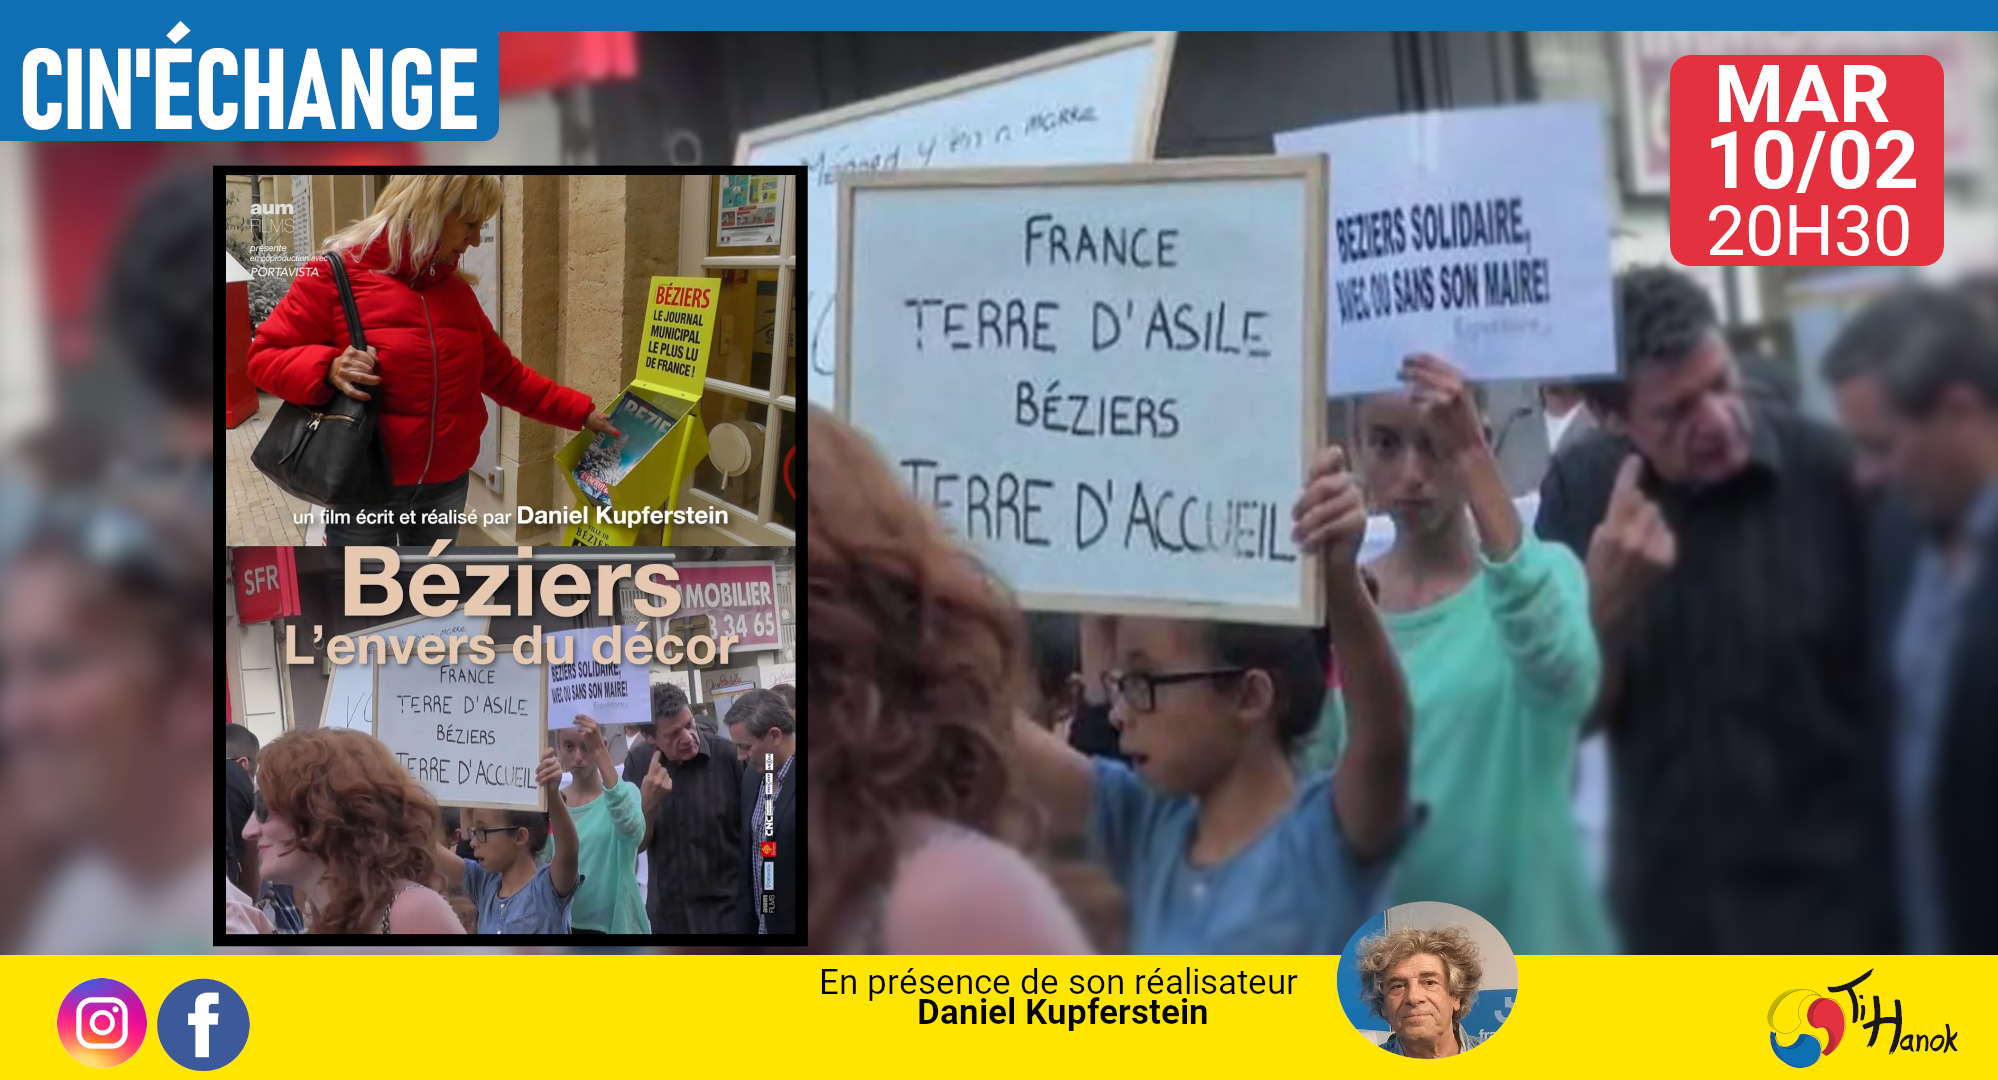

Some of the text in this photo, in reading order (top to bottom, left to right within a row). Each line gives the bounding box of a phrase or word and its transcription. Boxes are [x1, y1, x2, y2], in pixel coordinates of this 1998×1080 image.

[250, 203, 294, 215] aum
[250, 218, 295, 234] FILMS
[1411, 198, 1530, 254] SOLIDAIRE,
[1024, 214, 1179, 267] FRANCE
[261, 254, 309, 264] coproduction
[311, 254, 329, 262] avec
[250, 267, 320, 277] PORTAVISTA
[656, 283, 711, 309] BÉZIERS
[1393, 266, 1435, 315] SANS
[1440, 262, 1480, 309] SON
[1484, 258, 1550, 306] MAIRE!
[653, 310, 704, 327] LE JOURNAL
[905, 299, 1272, 357] TERRE D'ASILE
[651, 325, 701, 345] MUNICIPAL
[648, 341, 699, 362] LE PLUS LU
[646, 356, 657, 369] DE
[657, 358, 691, 377] FRANCE
[1016, 380, 1180, 438] BÉZIERS
[293, 505, 729, 528] un film écrit et réalisé par Daniel Kupferstein
[900, 459, 1298, 562] TERRE D'ACCUEIL
[244, 564, 280, 596] SFR
[344, 538, 682, 617] Béziers
[723, 613, 748, 638] 34
[753, 612, 776, 637] 65
[286, 625, 496, 665] L’envers
[512, 625, 574, 665] du
[592, 621, 740, 665] décor
[439, 664, 496, 684] FRANCE
[571, 682, 587, 701] SANS
[588, 681, 603, 700] SON
[604, 679, 628, 698] MAIRE!
[397, 694, 453, 714] TERRE
[464, 695, 528, 716] D'ASILE
[436, 724, 496, 745] BÉZIERS
[396, 752, 538, 789] TERRE D'ACCUEIL
[765, 815, 773, 836] CNC
